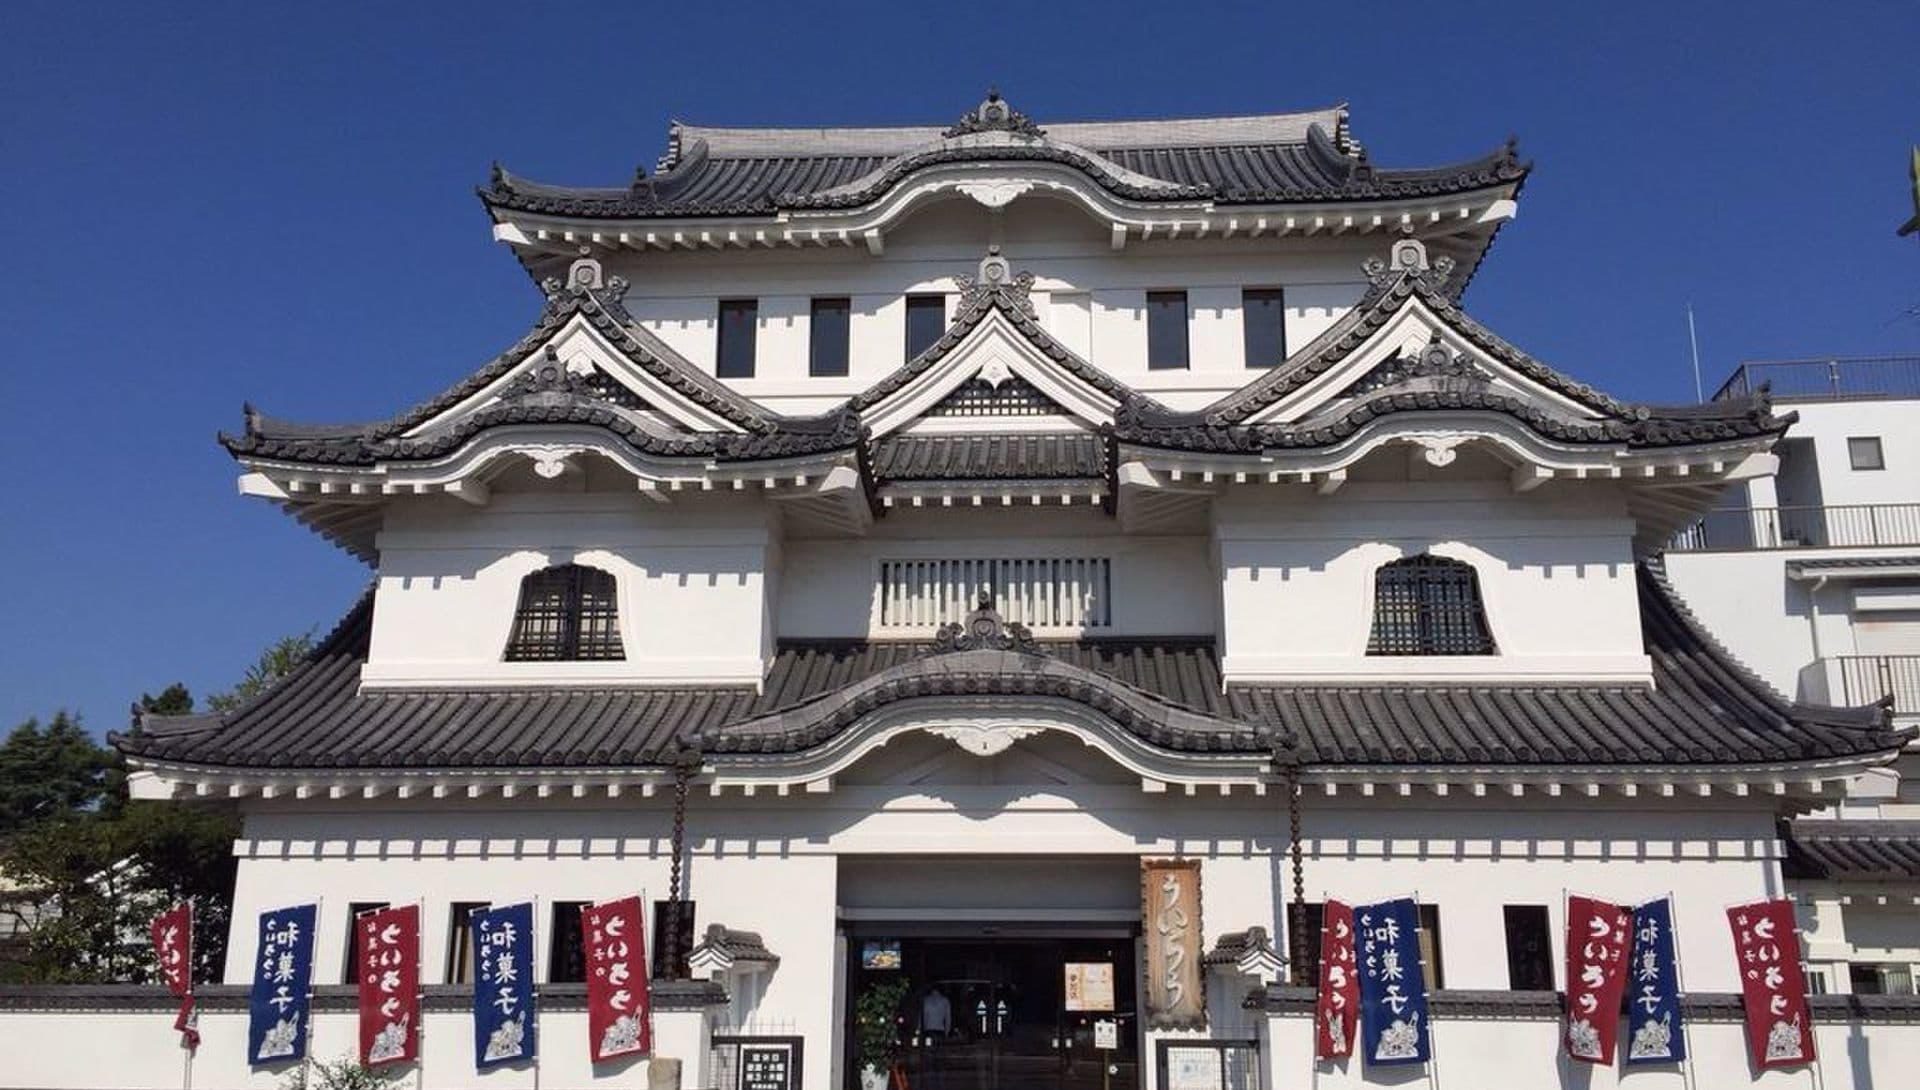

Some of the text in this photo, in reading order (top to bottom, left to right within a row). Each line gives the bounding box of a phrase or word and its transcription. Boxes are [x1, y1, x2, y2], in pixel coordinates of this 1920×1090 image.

[1157, 874, 1188, 1012] ういろう
[1328, 918, 1349, 1009] ういろう
[1579, 915, 1610, 1013] ういろう
